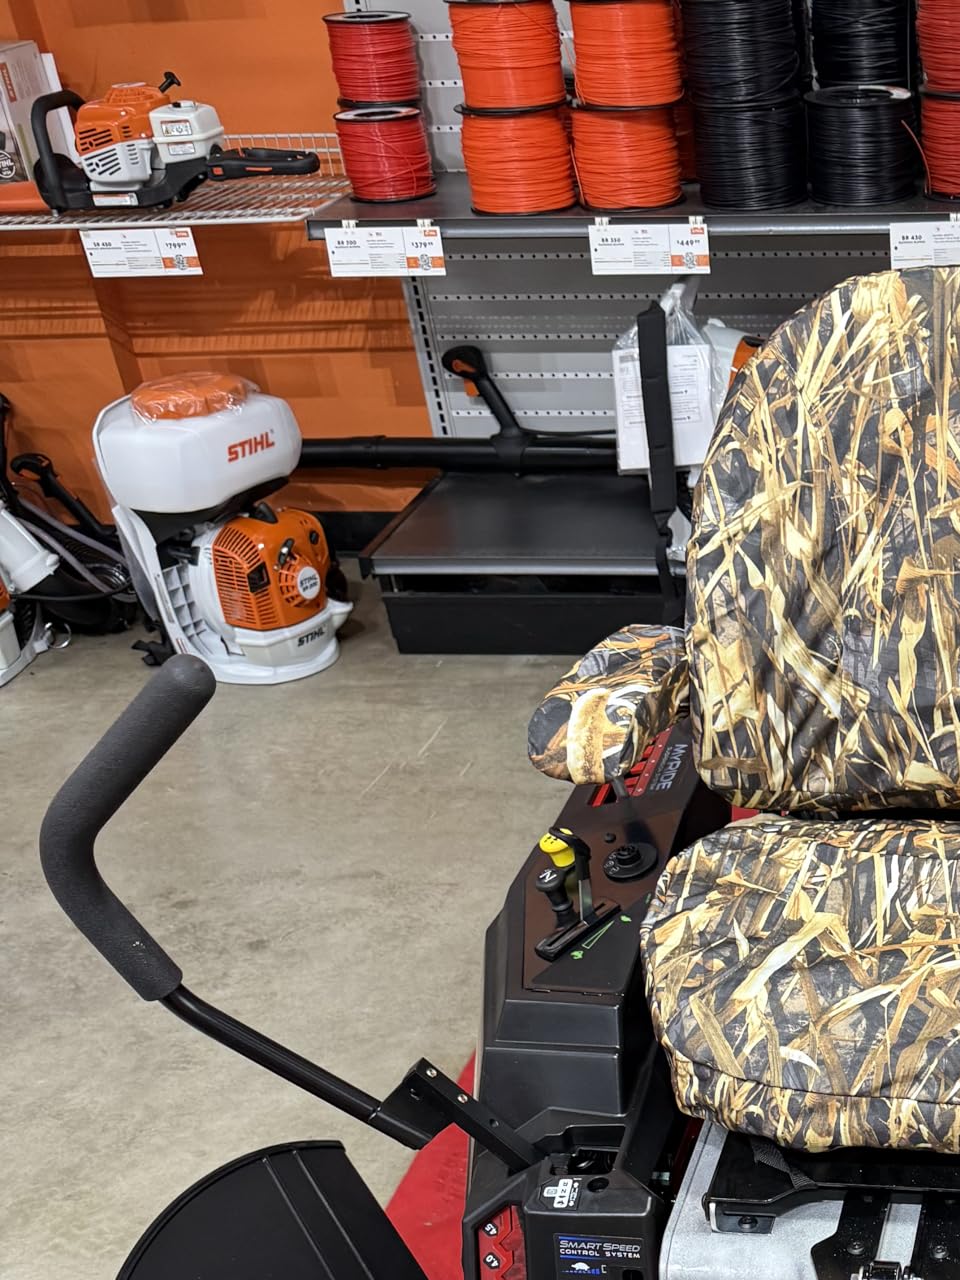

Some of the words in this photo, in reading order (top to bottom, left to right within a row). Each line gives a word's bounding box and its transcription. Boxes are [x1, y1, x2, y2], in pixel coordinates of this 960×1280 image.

[227, 431, 275, 463] STIHL
[297, 627, 326, 647] STIHL
[485, 1254, 499, 1268] 4.0
[559, 1248, 601, 1257] CONTROL
[604, 1251, 641, 1259] SYSTEM
